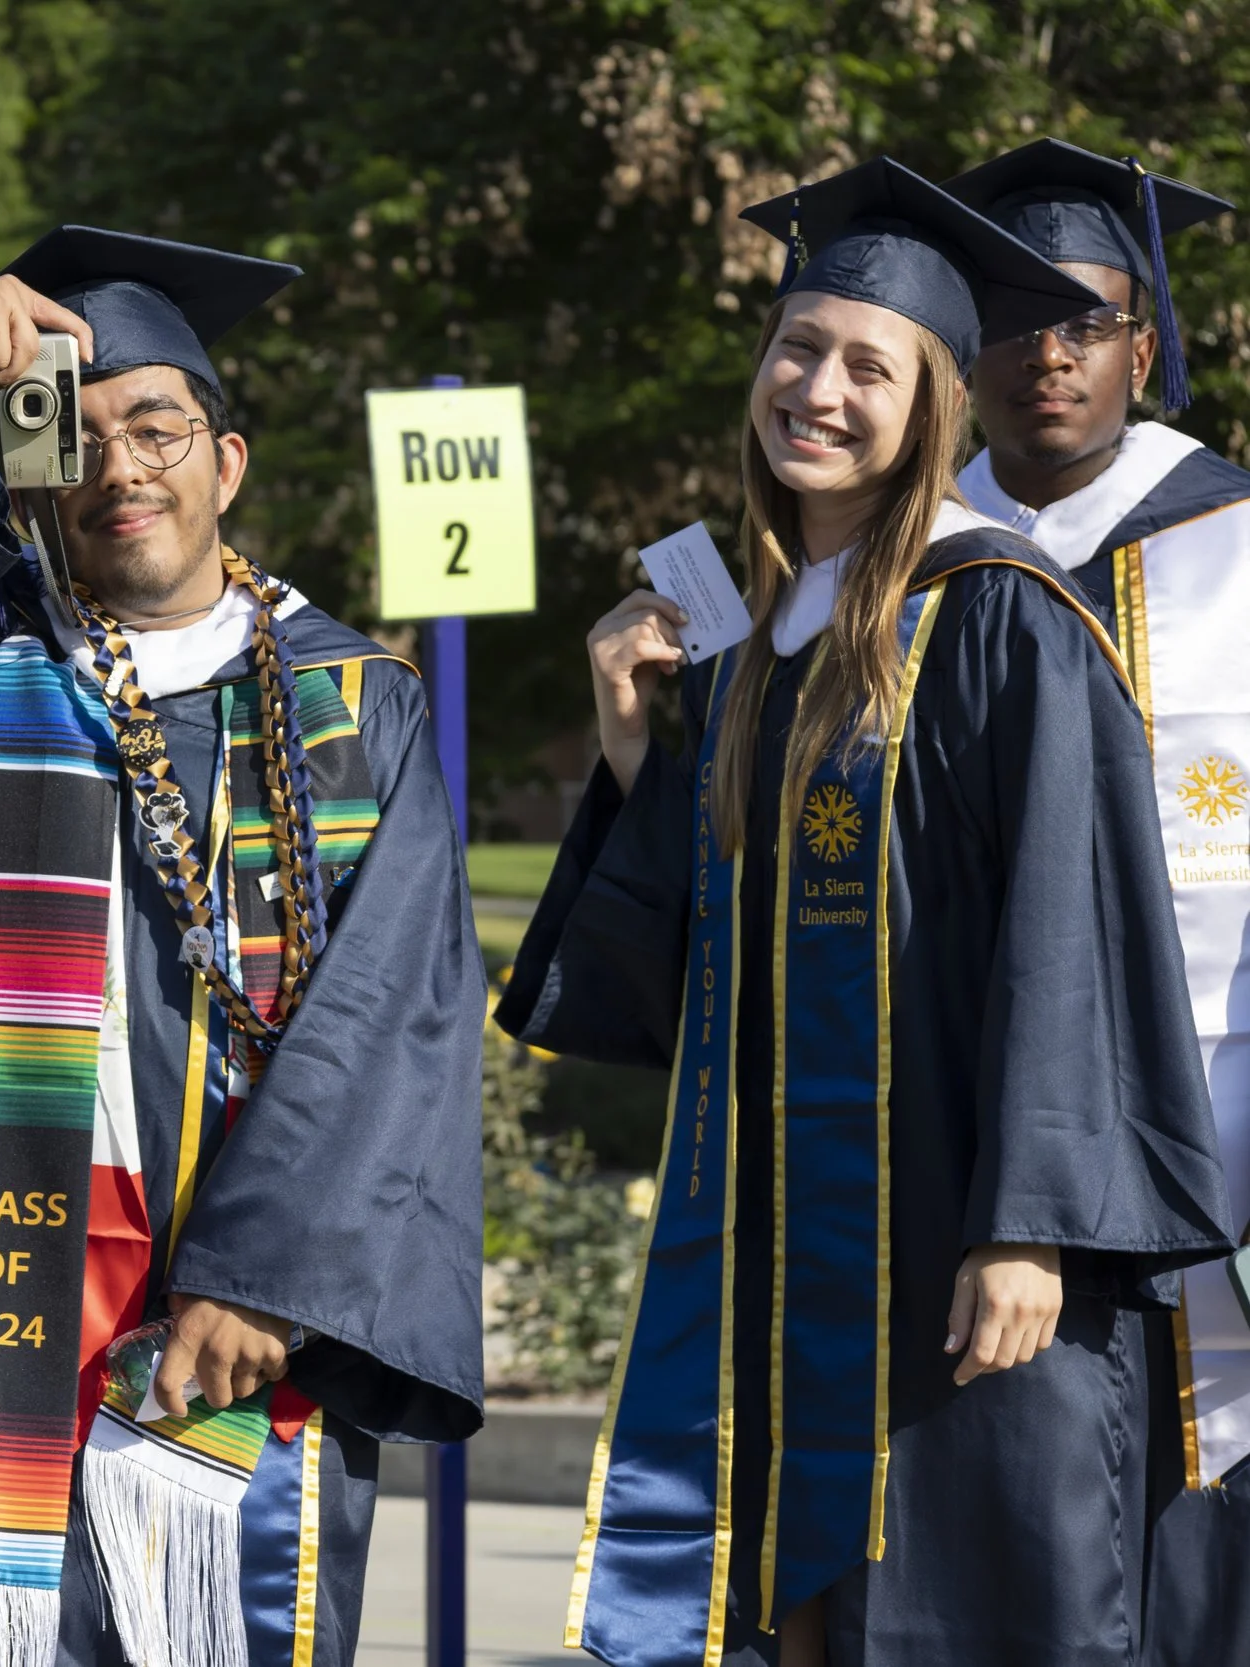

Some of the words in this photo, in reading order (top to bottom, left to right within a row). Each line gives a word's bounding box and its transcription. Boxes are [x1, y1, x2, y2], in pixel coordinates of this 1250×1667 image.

[444, 521, 470, 576] 2
[128, 728, 166, 757] 2024
[699, 762, 711, 918] CHANGE
[1178, 842, 1196, 858] La
[804, 879, 819, 897] La
[825, 878, 864, 896] Sierra
[1174, 866, 1250, 883] Universit
[798, 906, 869, 928] University
[702, 940, 714, 1044] YOUR
[690, 1066, 711, 1197] WORLD
